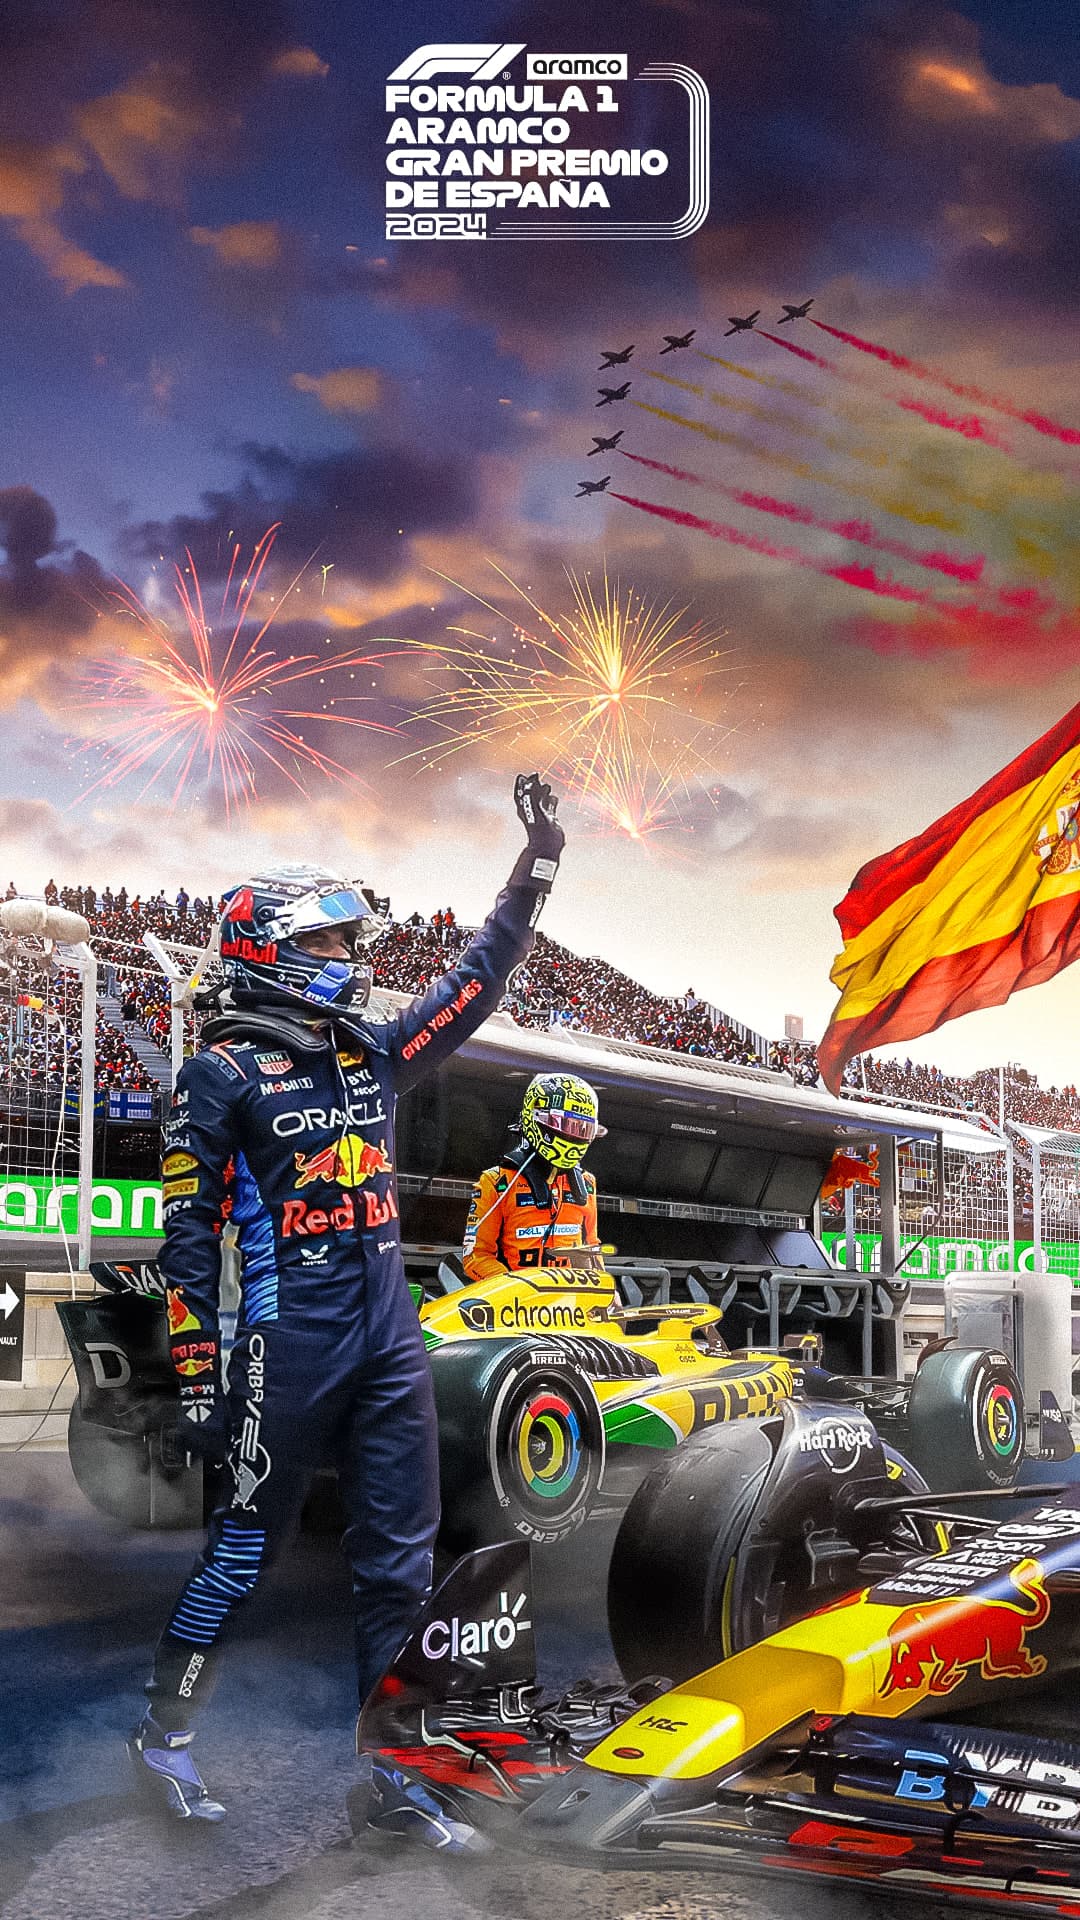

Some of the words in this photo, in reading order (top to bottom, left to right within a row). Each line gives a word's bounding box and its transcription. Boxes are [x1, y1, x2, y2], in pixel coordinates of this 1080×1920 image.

[241, 937, 278, 965] Bull
[401, 1028, 432, 1061] GIVES
[427, 1007, 454, 1032] YOU
[271, 1098, 387, 1138] ORACLE
[281, 1192, 355, 1238] Red
[500, 1297, 585, 1328] chrome
[422, 1612, 518, 1660] Claro
